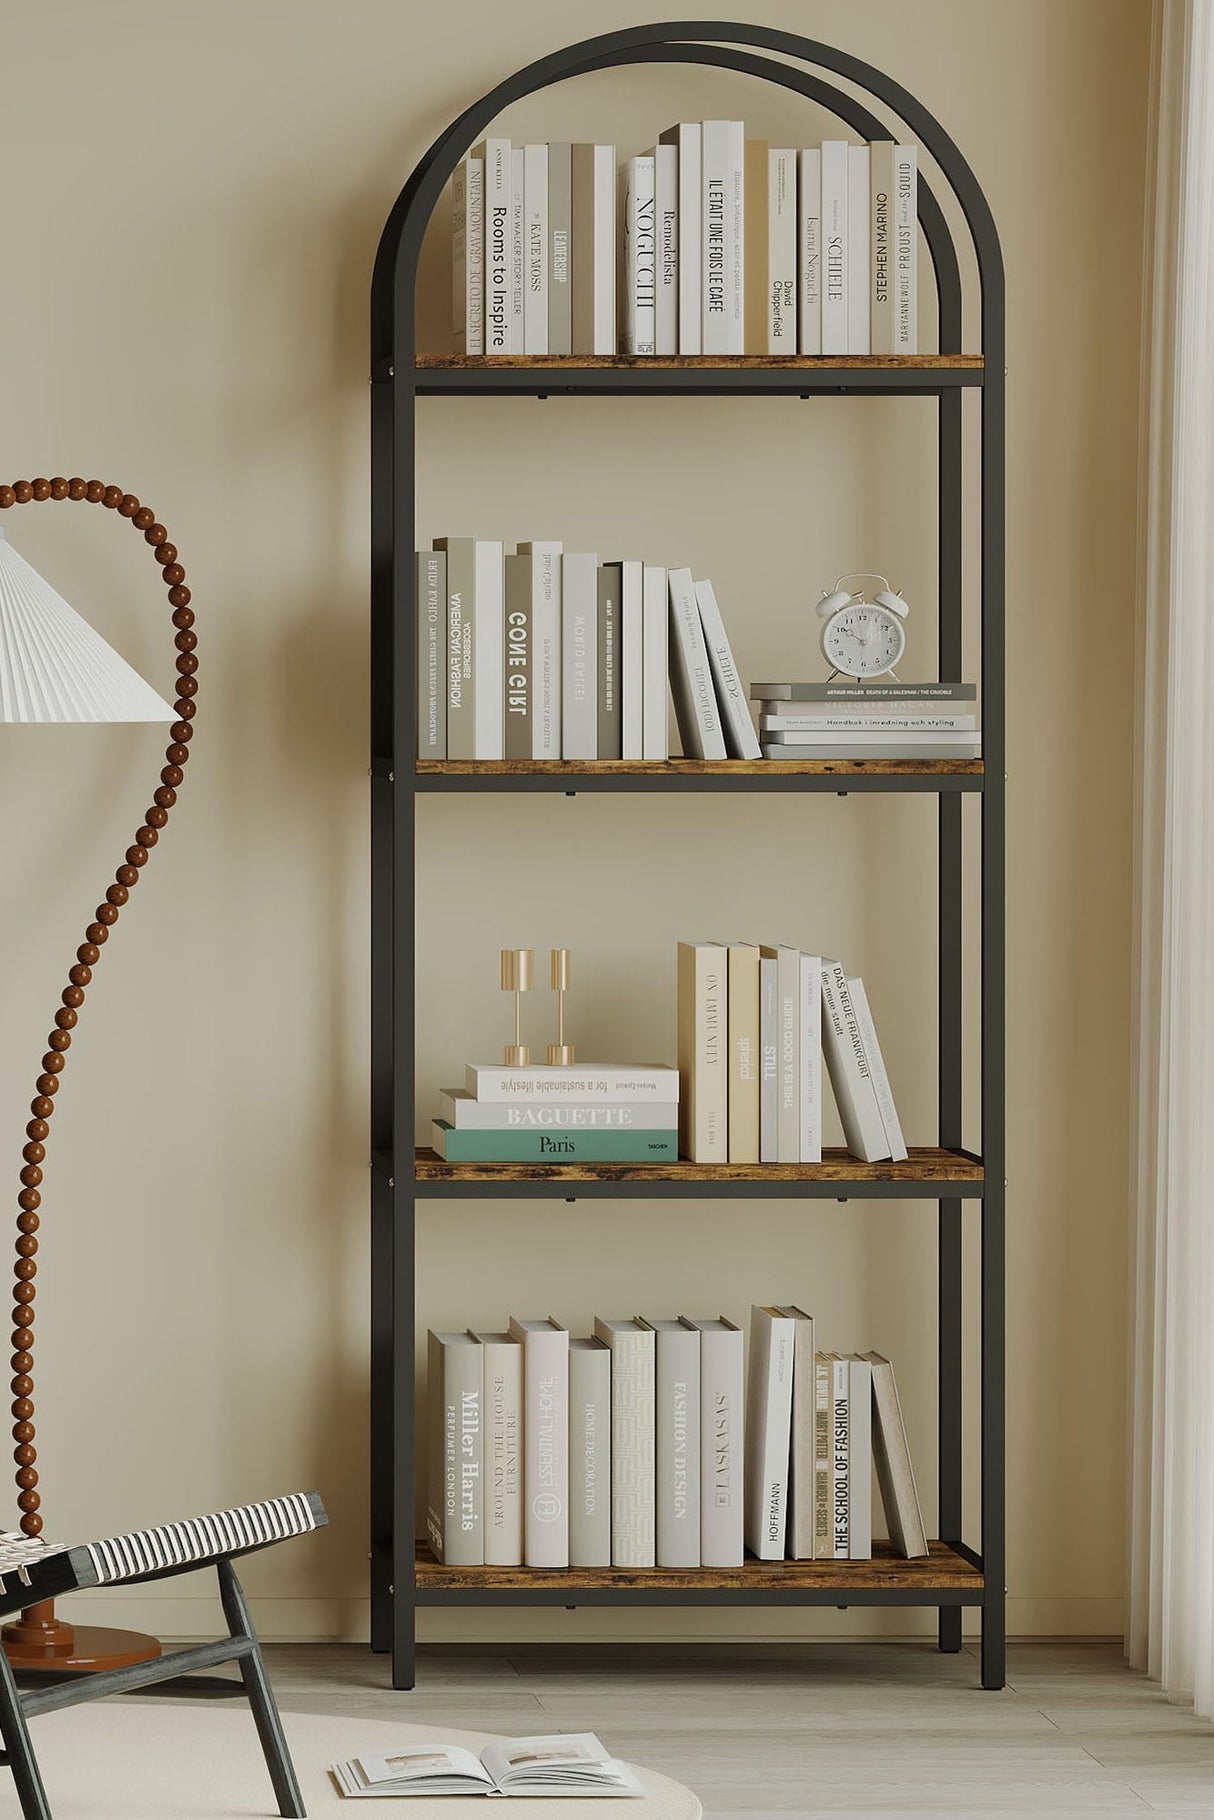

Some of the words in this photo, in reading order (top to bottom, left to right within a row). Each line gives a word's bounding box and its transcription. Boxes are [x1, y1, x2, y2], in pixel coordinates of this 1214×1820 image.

[709, 180, 723, 189] IL
[899, 163, 910, 198] SQUID
[469, 170, 481, 234] MOUNTAIN
[709, 192, 725, 219] ÉTAIT
[877, 193, 888, 241] MARINO
[469, 236, 481, 264] GRAY
[493, 207, 507, 262] Rooms
[531, 224, 541, 254] KATE
[663, 211, 676, 285] Remodelista
[709, 224, 723, 243] UNE
[807, 217, 819, 250] Isamu
[899, 224, 910, 269] PROUST
[554, 230, 567, 283] LEADERSHIP
[636, 198, 654, 307] NOGUCHI
[709, 246, 723, 270] FOIS
[828, 237, 842, 301] SCHIELE
[469, 270, 481, 284] DE
[493, 267, 506, 284] to
[531, 259, 541, 292] MOSS
[709, 272, 723, 283] LE
[805, 254, 819, 304] Noguchi
[877, 246, 888, 302] STEPHEN
[900, 275, 909, 296] WOLF
[709, 286, 725, 312] CAFÉ
[773, 281, 783, 337] Chipperfield
[784, 281, 793, 306] David
[469, 288, 481, 334] SECRETO
[489, 290, 507, 346] Inspire
[900, 299, 909, 342] MARYANNE
[706, 975, 717, 991] ON
[784, 997, 793, 1029] GUIDE
[821, 971, 829, 985] die
[832, 1011, 844, 1036] stadt
[706, 998, 717, 1065] IMMUNITY
[833, 967, 845, 989] DAS
[839, 990, 853, 1018] NEUE
[848, 1020, 869, 1080] FRANKFURT
[764, 1046, 776, 1080] STILL
[784, 1031, 793, 1062] GOOD
[501, 1080, 533, 1092] lifestyle
[536, 1081, 585, 1092] sustainable
[588, 1083, 593, 1092] a
[596, 1081, 608, 1093] for
[784, 1073, 793, 1084] IS
[784, 1085, 793, 1109] THIS
[507, 1108, 632, 1125] BAGUETTE
[540, 1136, 575, 1153] Paris
[495, 1376, 504, 1425] HOUSE
[539, 1376, 553, 1419] HOME
[462, 1391, 479, 1456] Miller
[585, 1404, 595, 1438] HOME
[674, 1382, 688, 1452] FASHION
[816, 1412, 828, 1433] HARRY
[835, 1399, 848, 1451] FASHION
[495, 1432, 504, 1460] THE
[507, 1412, 516, 1494] FURNITURE
[539, 1422, 553, 1487] ESSENTIAL
[816, 1435, 828, 1459] POTTER
[835, 1455, 848, 1470] OF
[585, 1442, 595, 1515] DECORATION
[674, 1457, 688, 1519] DESIGN
[462, 1462, 479, 1531] Harris
[495, 1467, 504, 1528] AROUND
[769, 1483, 781, 1542] HOFFMANN
[835, 1473, 848, 1524] SCHOOL
[816, 1509, 828, 1536] SECRETS
[835, 1527, 848, 1551] THE
